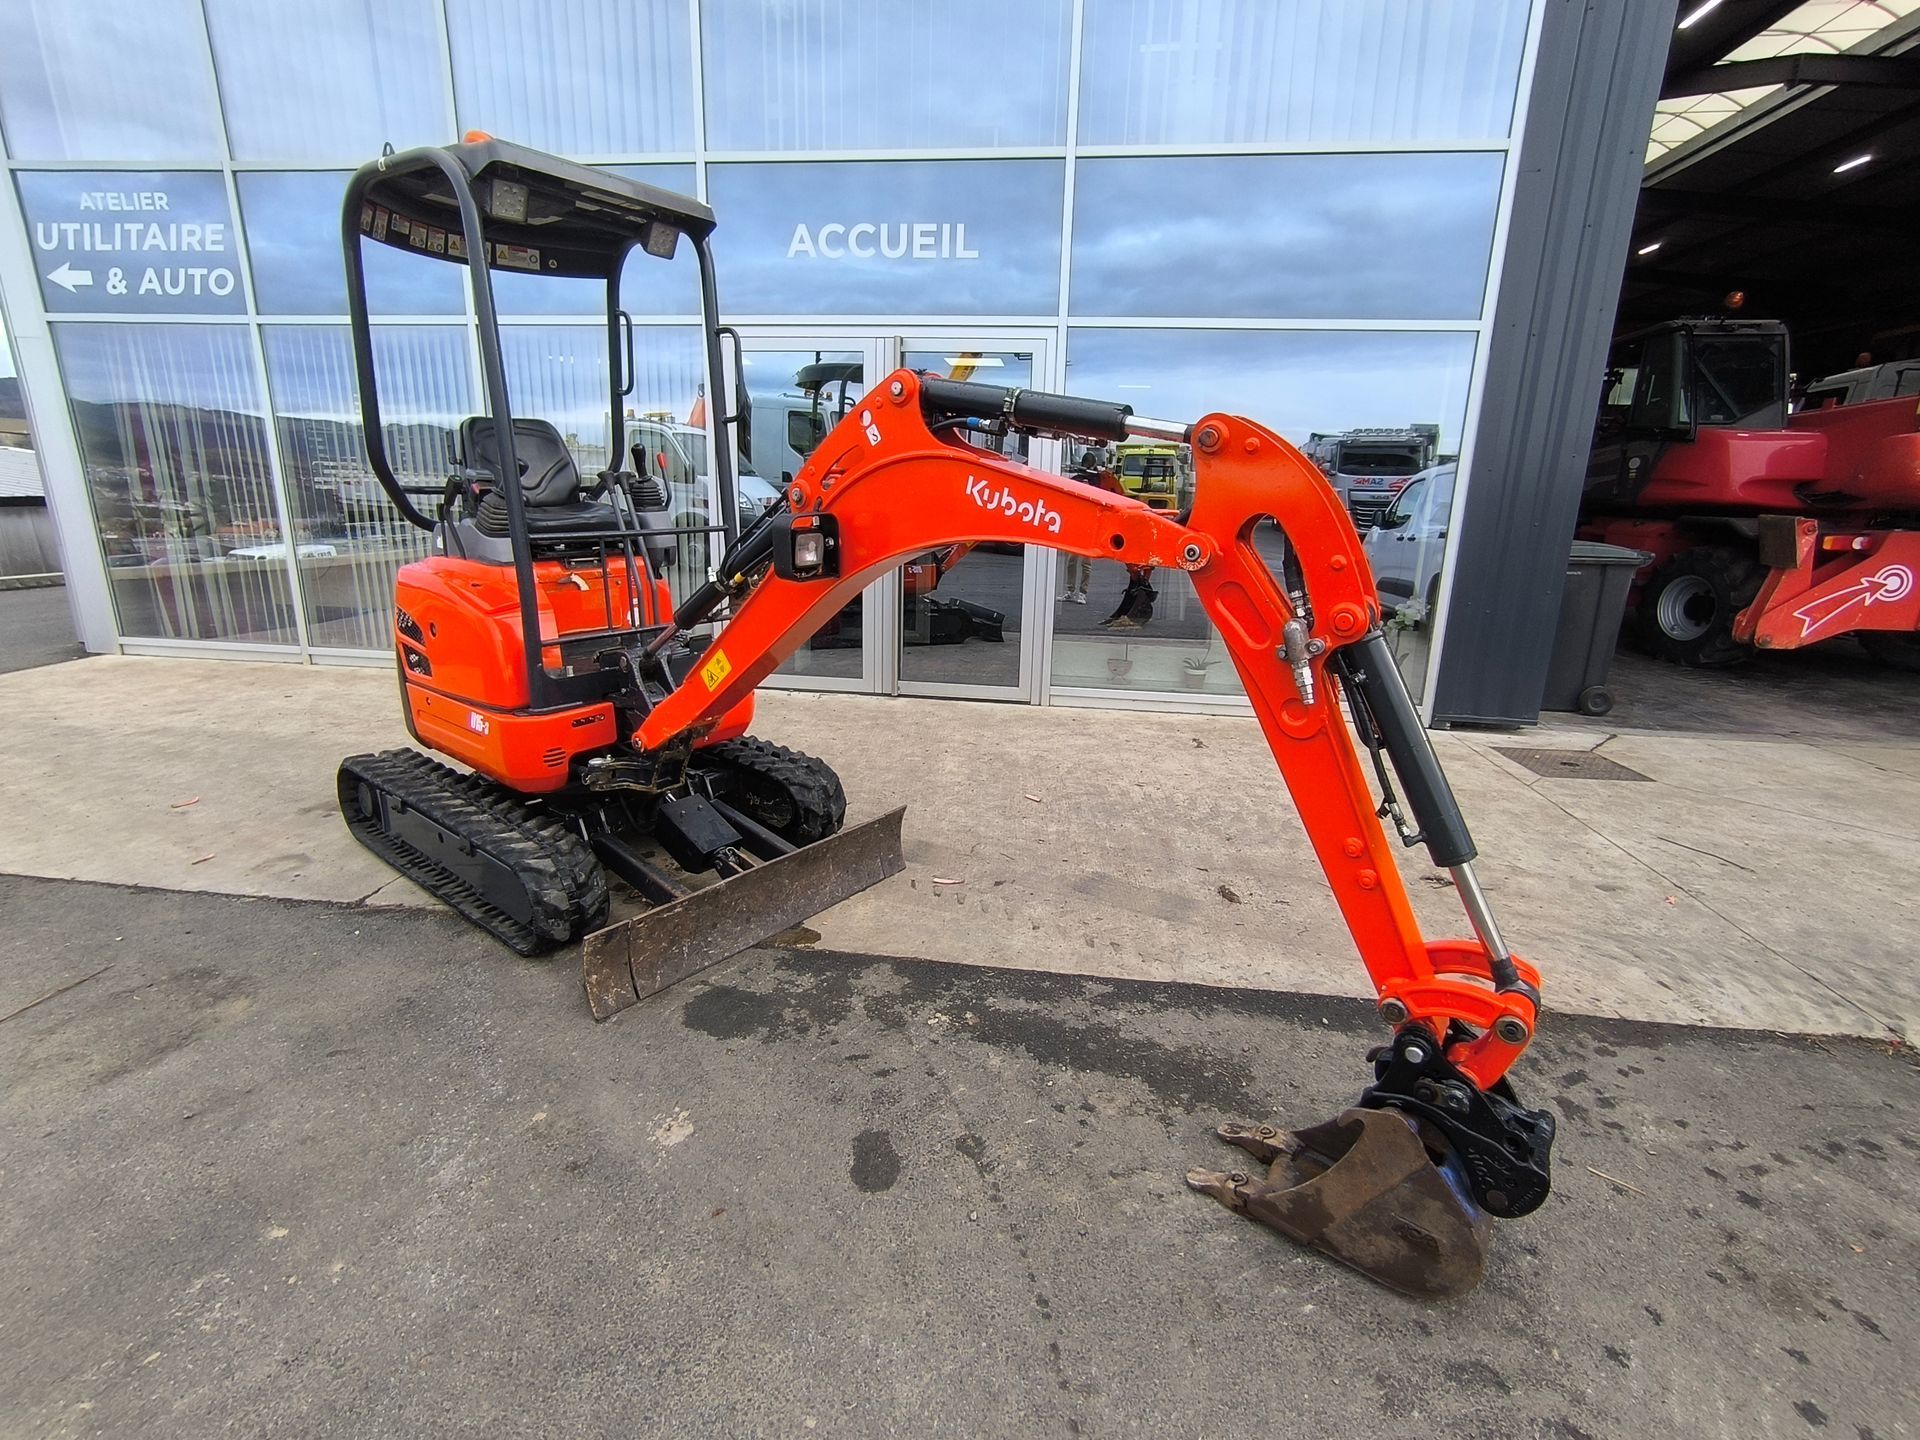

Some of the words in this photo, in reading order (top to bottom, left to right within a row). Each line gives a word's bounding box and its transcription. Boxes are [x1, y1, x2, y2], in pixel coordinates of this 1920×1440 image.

[79, 191, 170, 211] ATELIER
[36, 222, 225, 251] UTILITAIRE
[786, 223, 979, 258] ACCUEIL
[105, 266, 128, 295] &
[138, 266, 235, 296] AUTO
[965, 475, 1062, 533] Kubota
